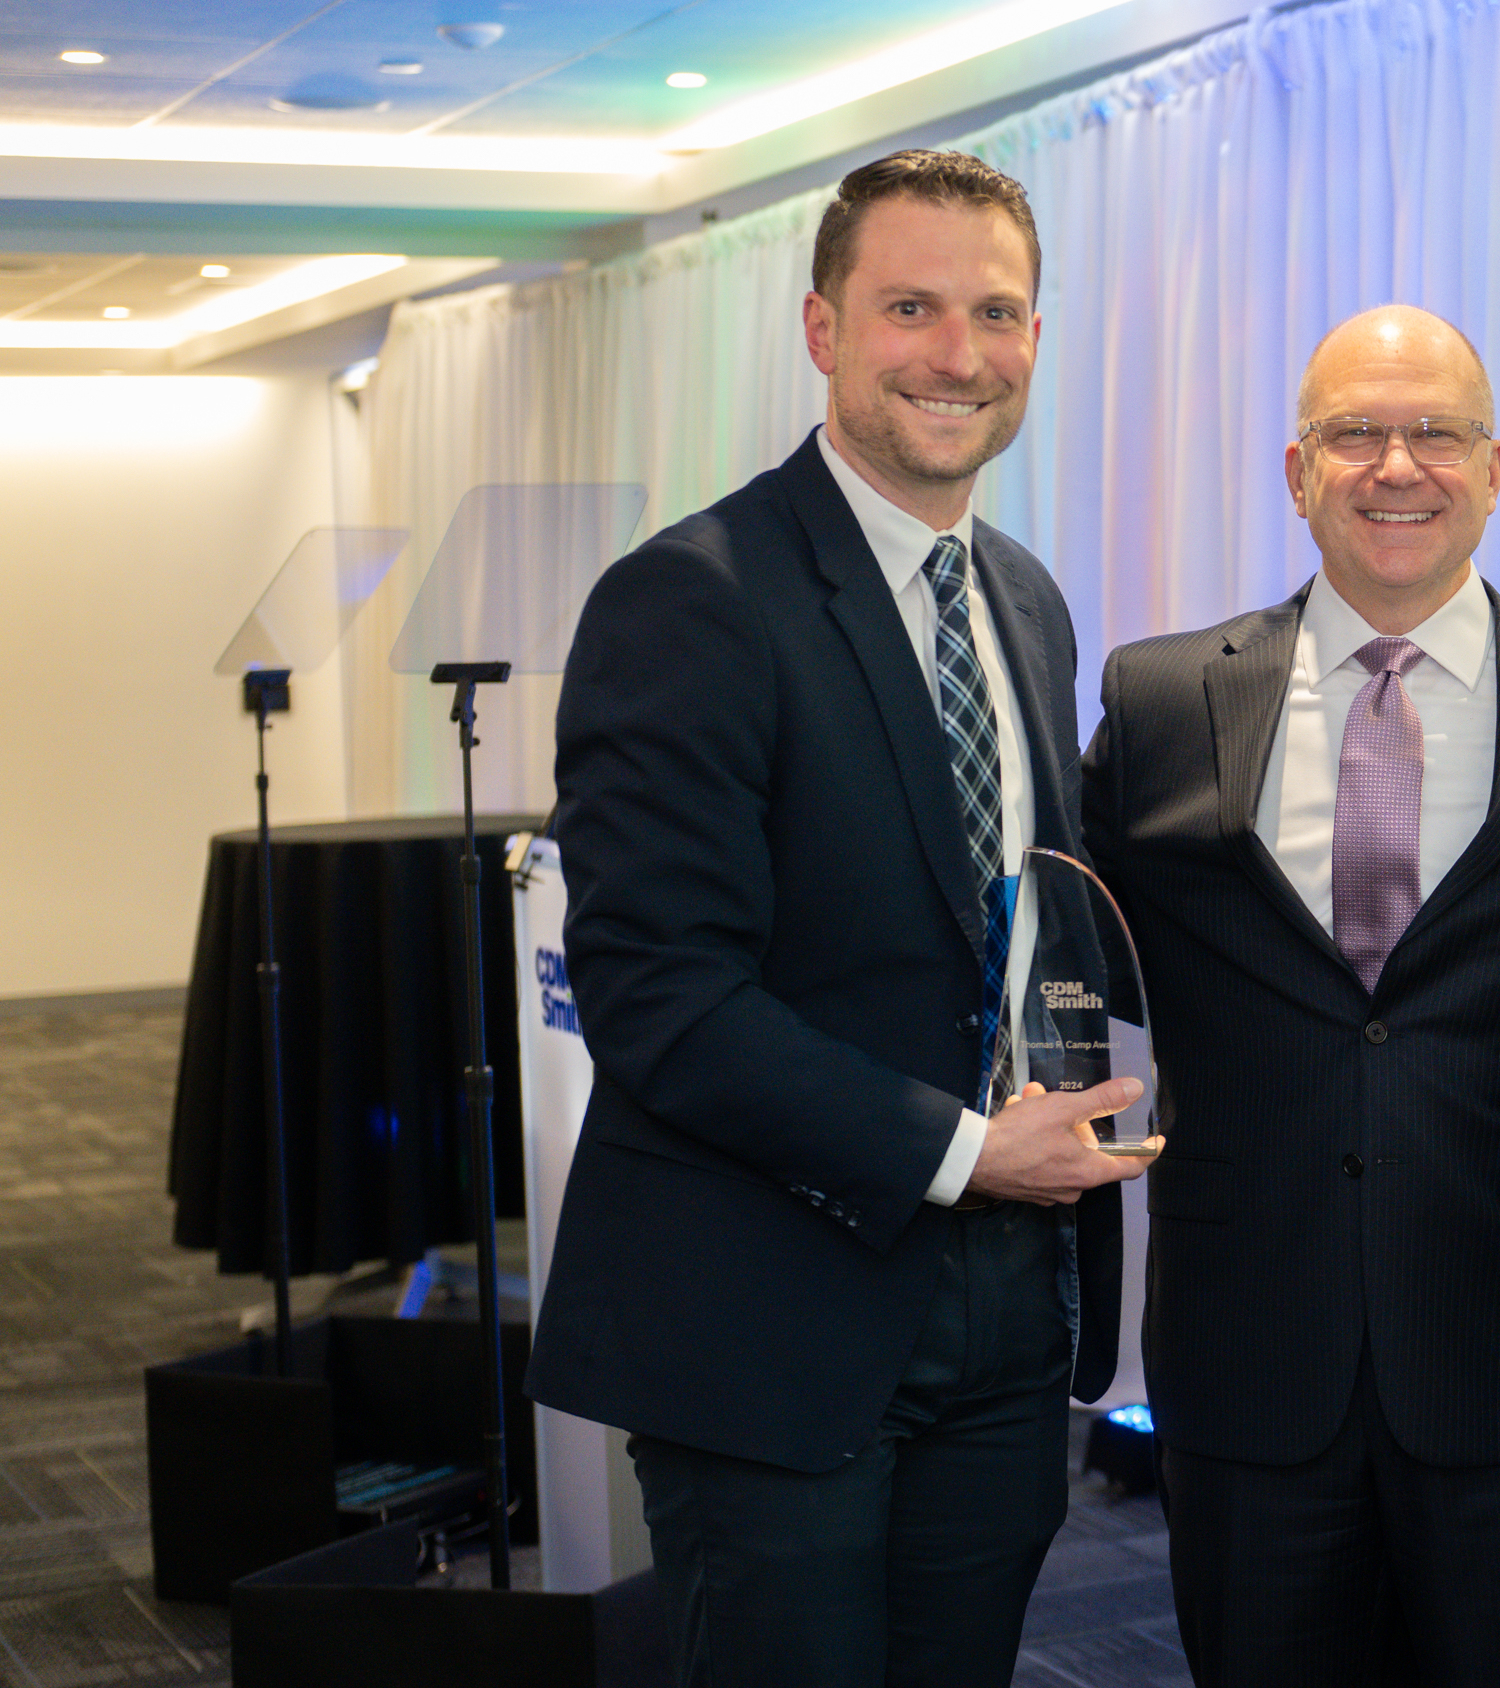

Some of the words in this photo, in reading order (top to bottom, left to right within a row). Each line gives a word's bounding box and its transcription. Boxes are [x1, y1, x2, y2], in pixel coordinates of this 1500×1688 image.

[1039, 981, 1084, 996] CDM
[1045, 993, 1104, 1009] Smith
[1021, 1040, 1055, 1049] Thomas
[1065, 1040, 1092, 1051] Camp
[1092, 1040, 1120, 1049] Award
[1058, 1081, 1084, 1090] 2024
